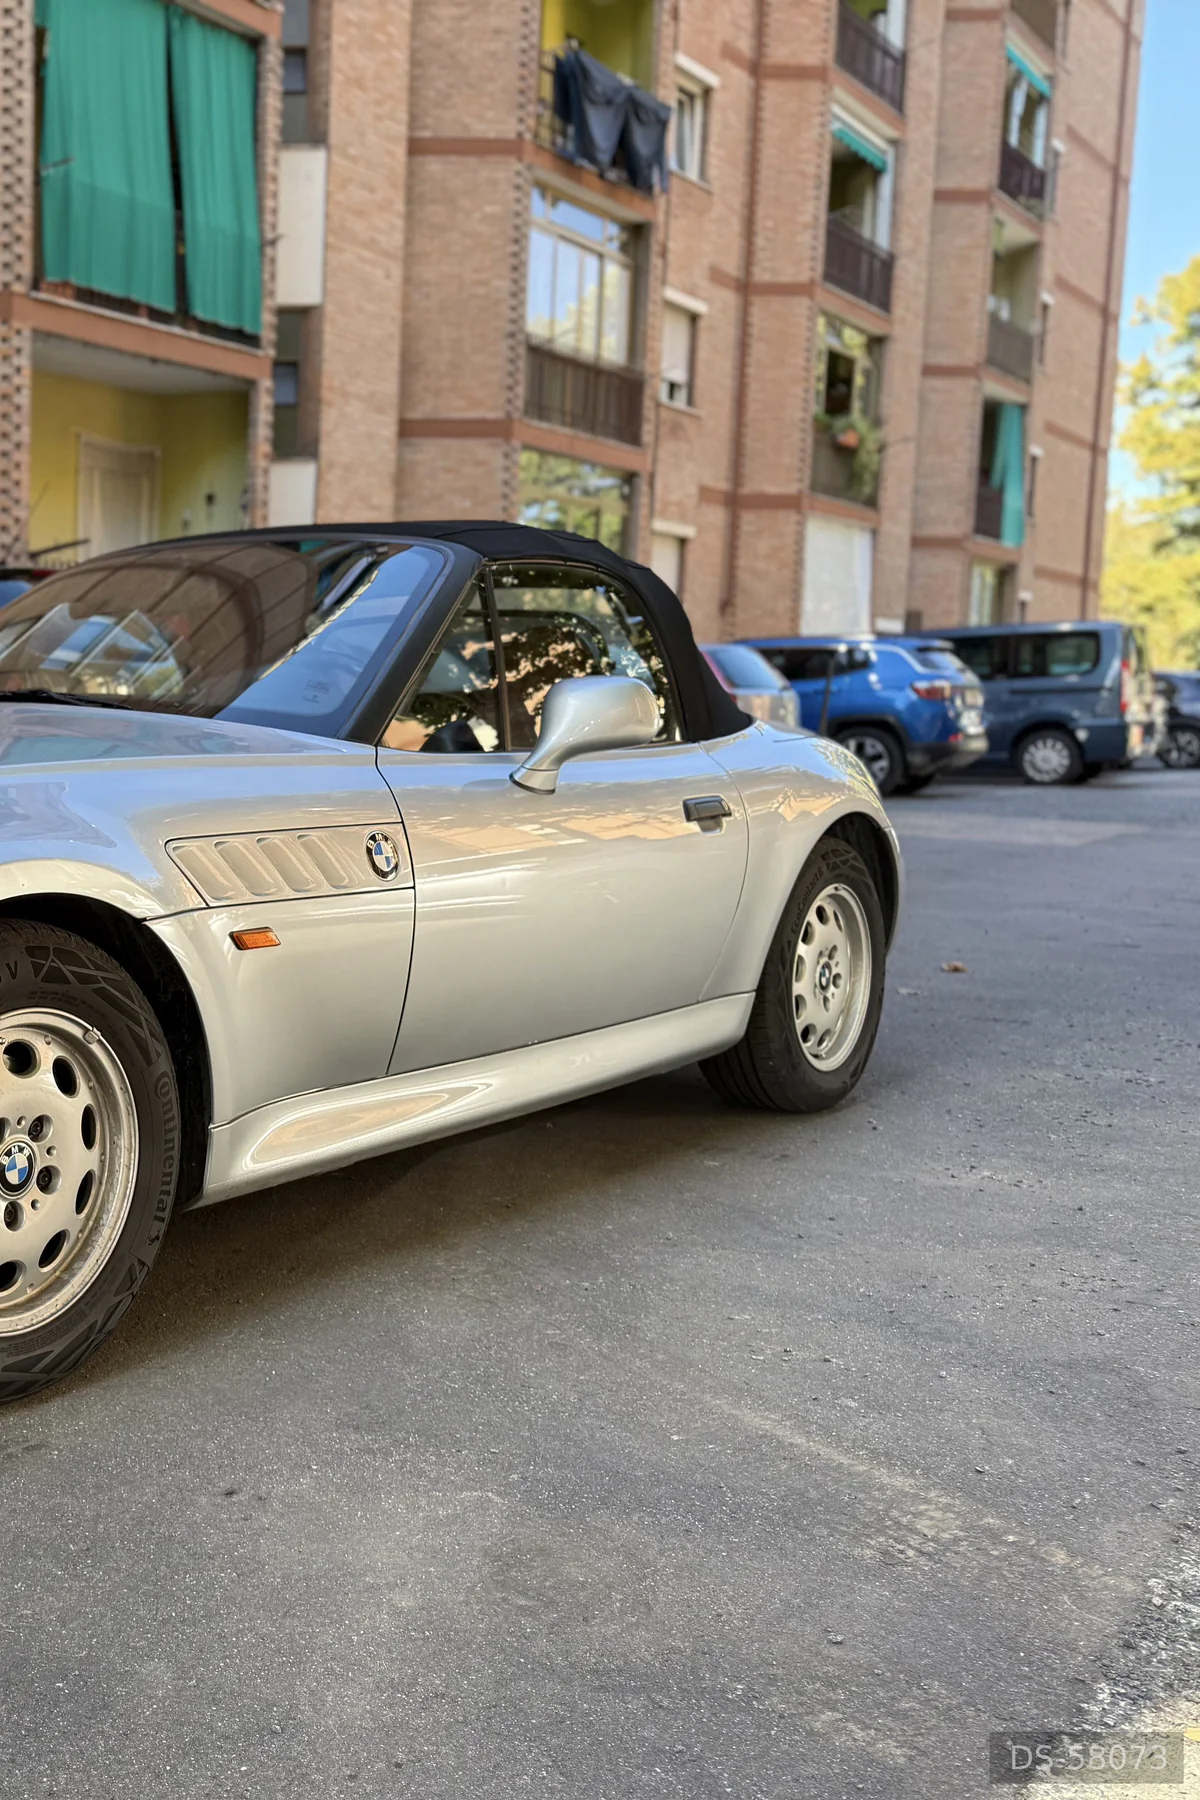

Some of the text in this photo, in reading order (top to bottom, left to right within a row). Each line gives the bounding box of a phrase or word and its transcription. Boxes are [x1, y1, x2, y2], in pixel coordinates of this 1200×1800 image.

[5, 960, 18, 980] V
[0, 1144, 31, 1165] BMW
[153, 1070, 178, 1223] Continental
